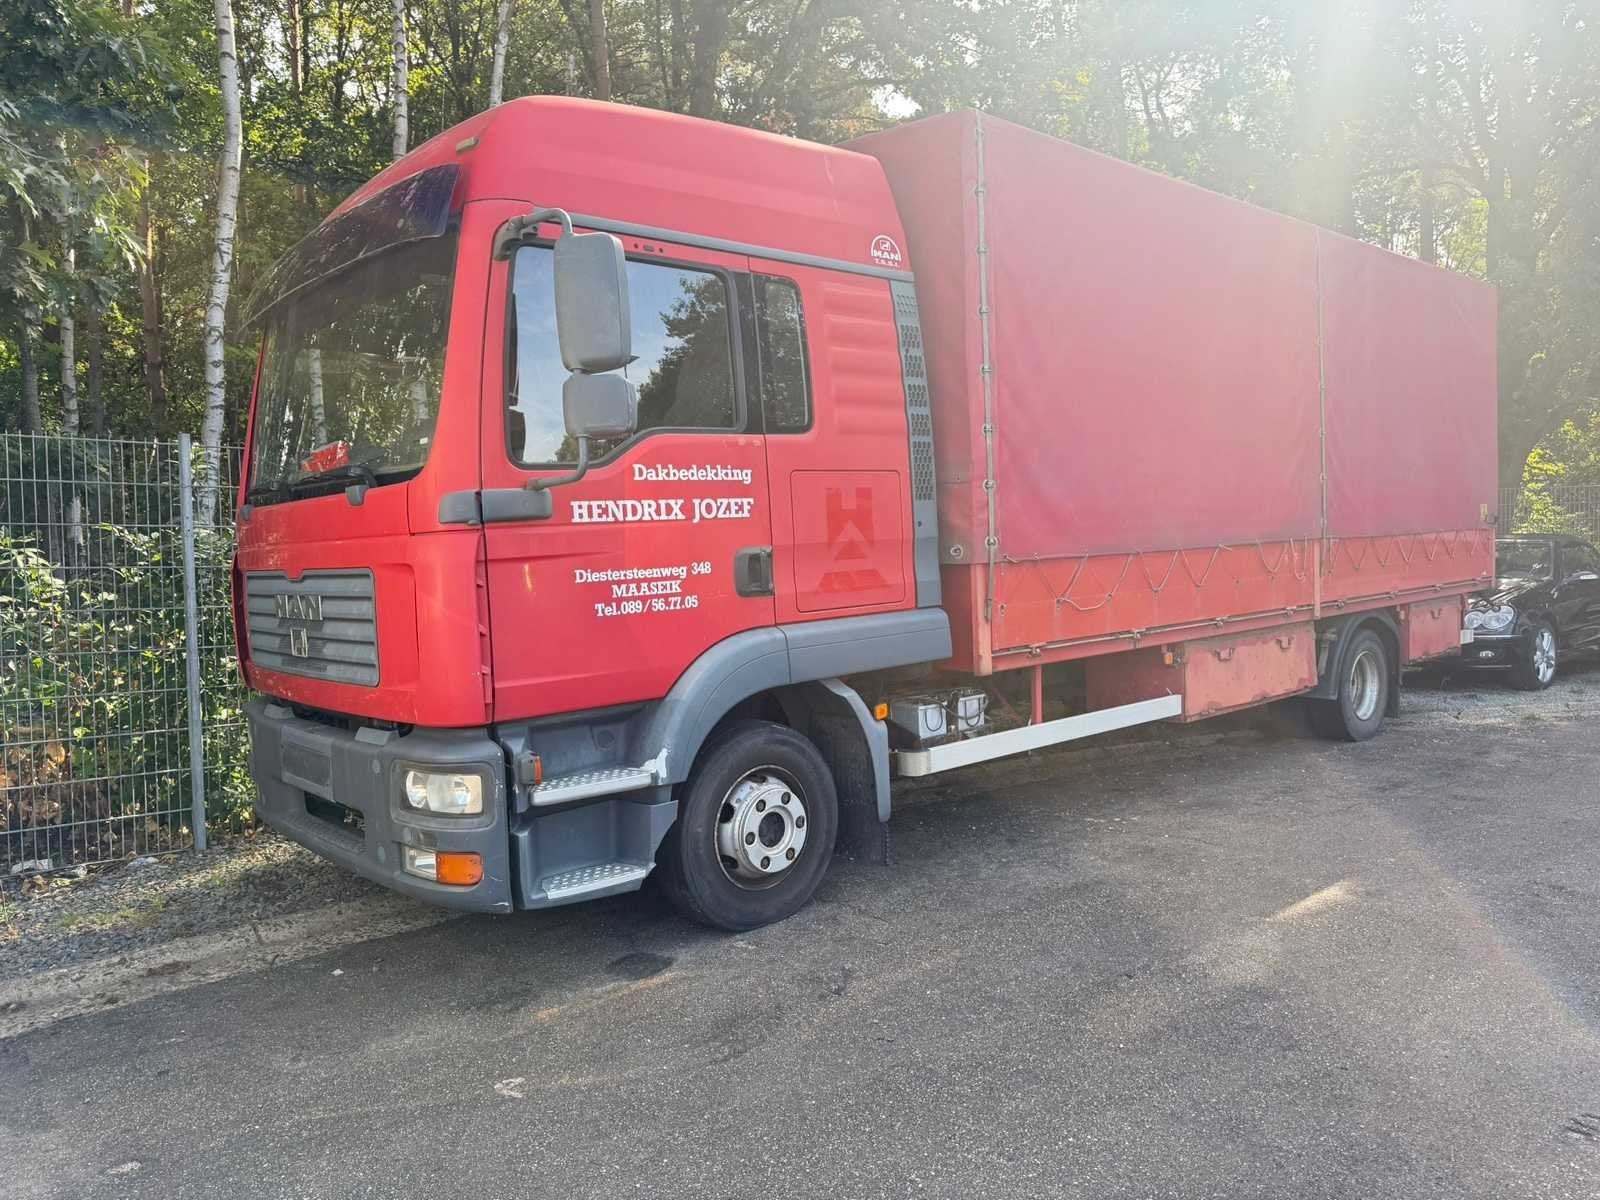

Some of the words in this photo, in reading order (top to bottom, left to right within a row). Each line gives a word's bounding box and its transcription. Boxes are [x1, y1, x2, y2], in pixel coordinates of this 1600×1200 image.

[873, 249, 899, 261] MAN
[632, 463, 752, 484] Dakbedekking
[570, 498, 686, 523] HENDRIX
[692, 497, 754, 523] JOZEF
[574, 565, 688, 584] Diestersteenweg
[691, 561, 712, 576] 348
[611, 580, 682, 598] MAASEIK
[273, 594, 323, 620] MAN
